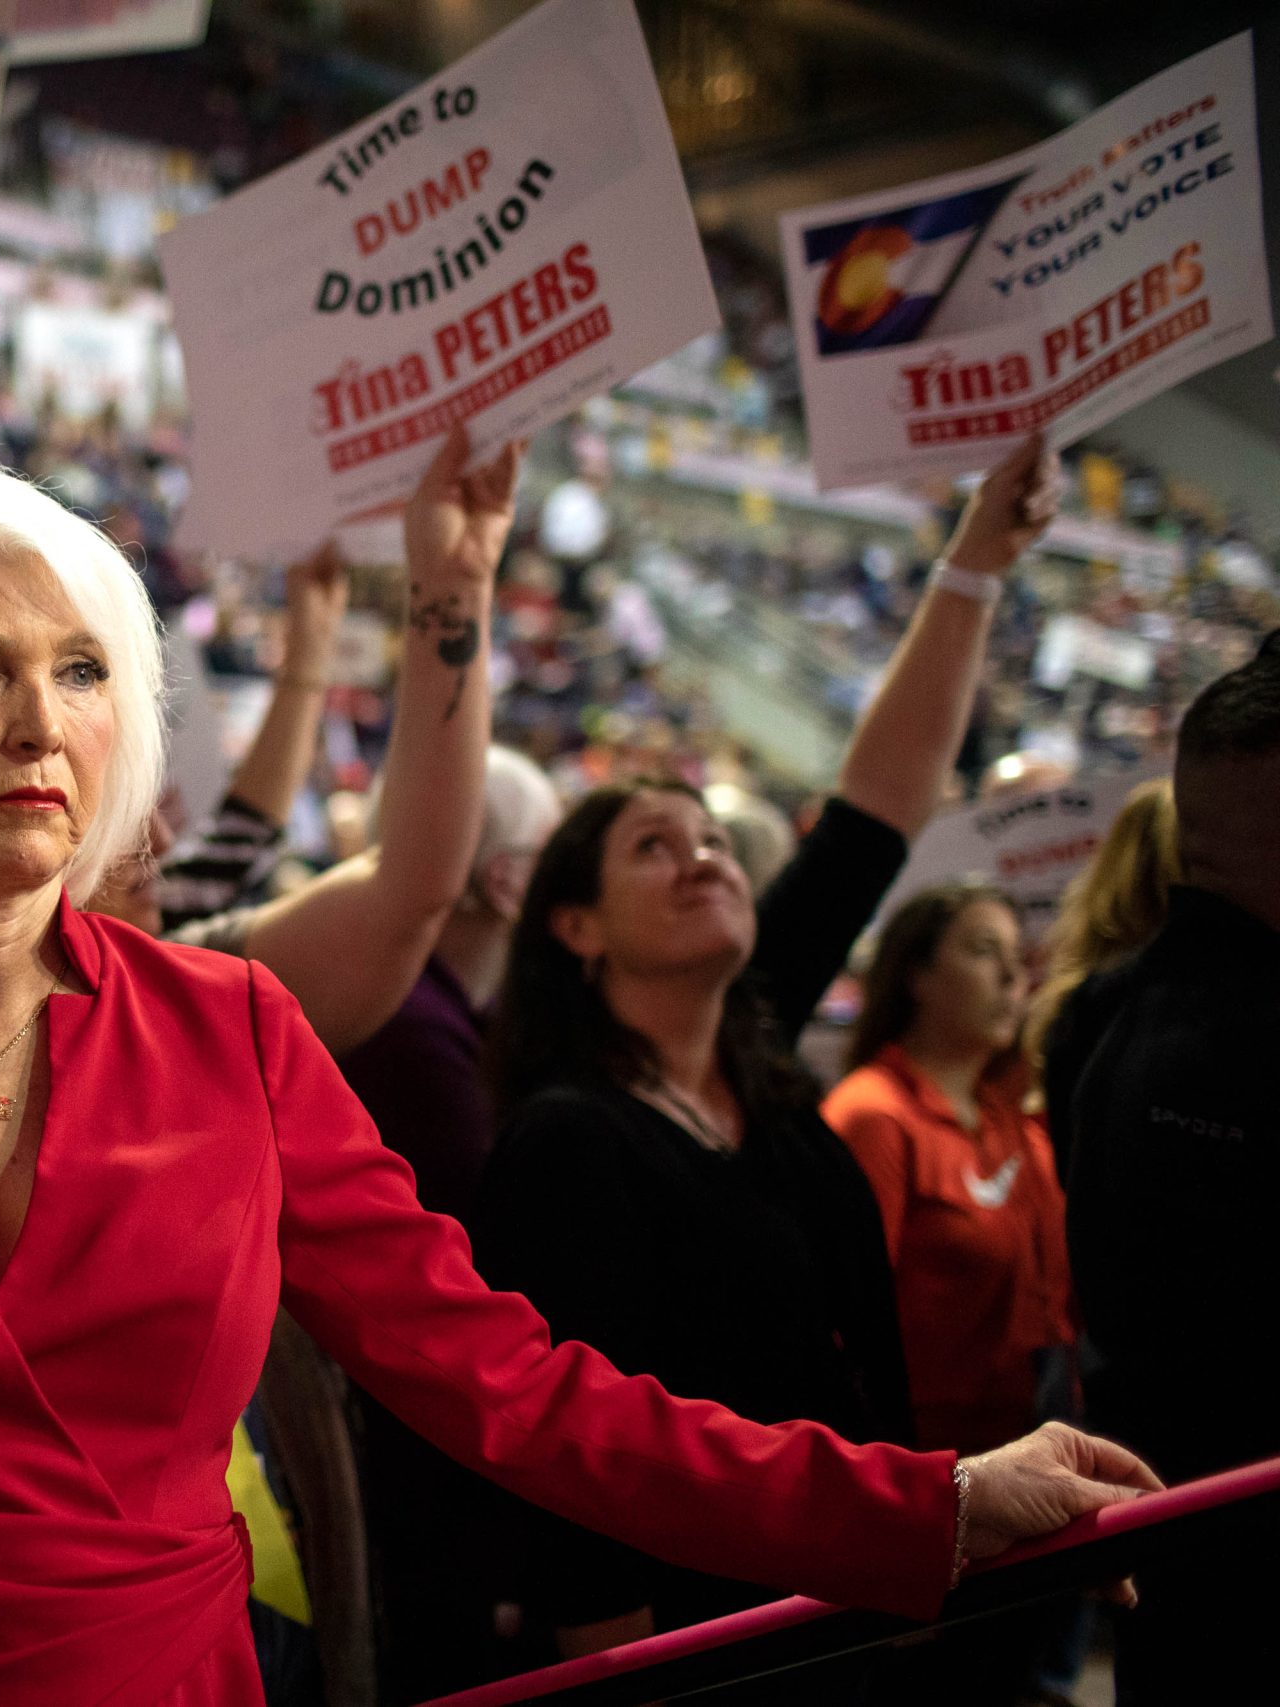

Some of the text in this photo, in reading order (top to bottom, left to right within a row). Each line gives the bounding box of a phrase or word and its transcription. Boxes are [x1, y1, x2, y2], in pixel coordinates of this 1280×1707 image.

[317, 85, 476, 196] Time to
[352, 147, 493, 257] DUMP
[996, 121, 1222, 257] YOUR VOTE
[1020, 164, 1095, 213] Truth
[315, 158, 554, 316] Dominion
[992, 152, 1235, 297] YOUR VOICE
[313, 352, 431, 430] Tina
[434, 241, 597, 382] PETERS
[902, 348, 1031, 409] Tina
[1042, 240, 1206, 379] PETERS
[1150, 1105, 1244, 1143] SPYDER
